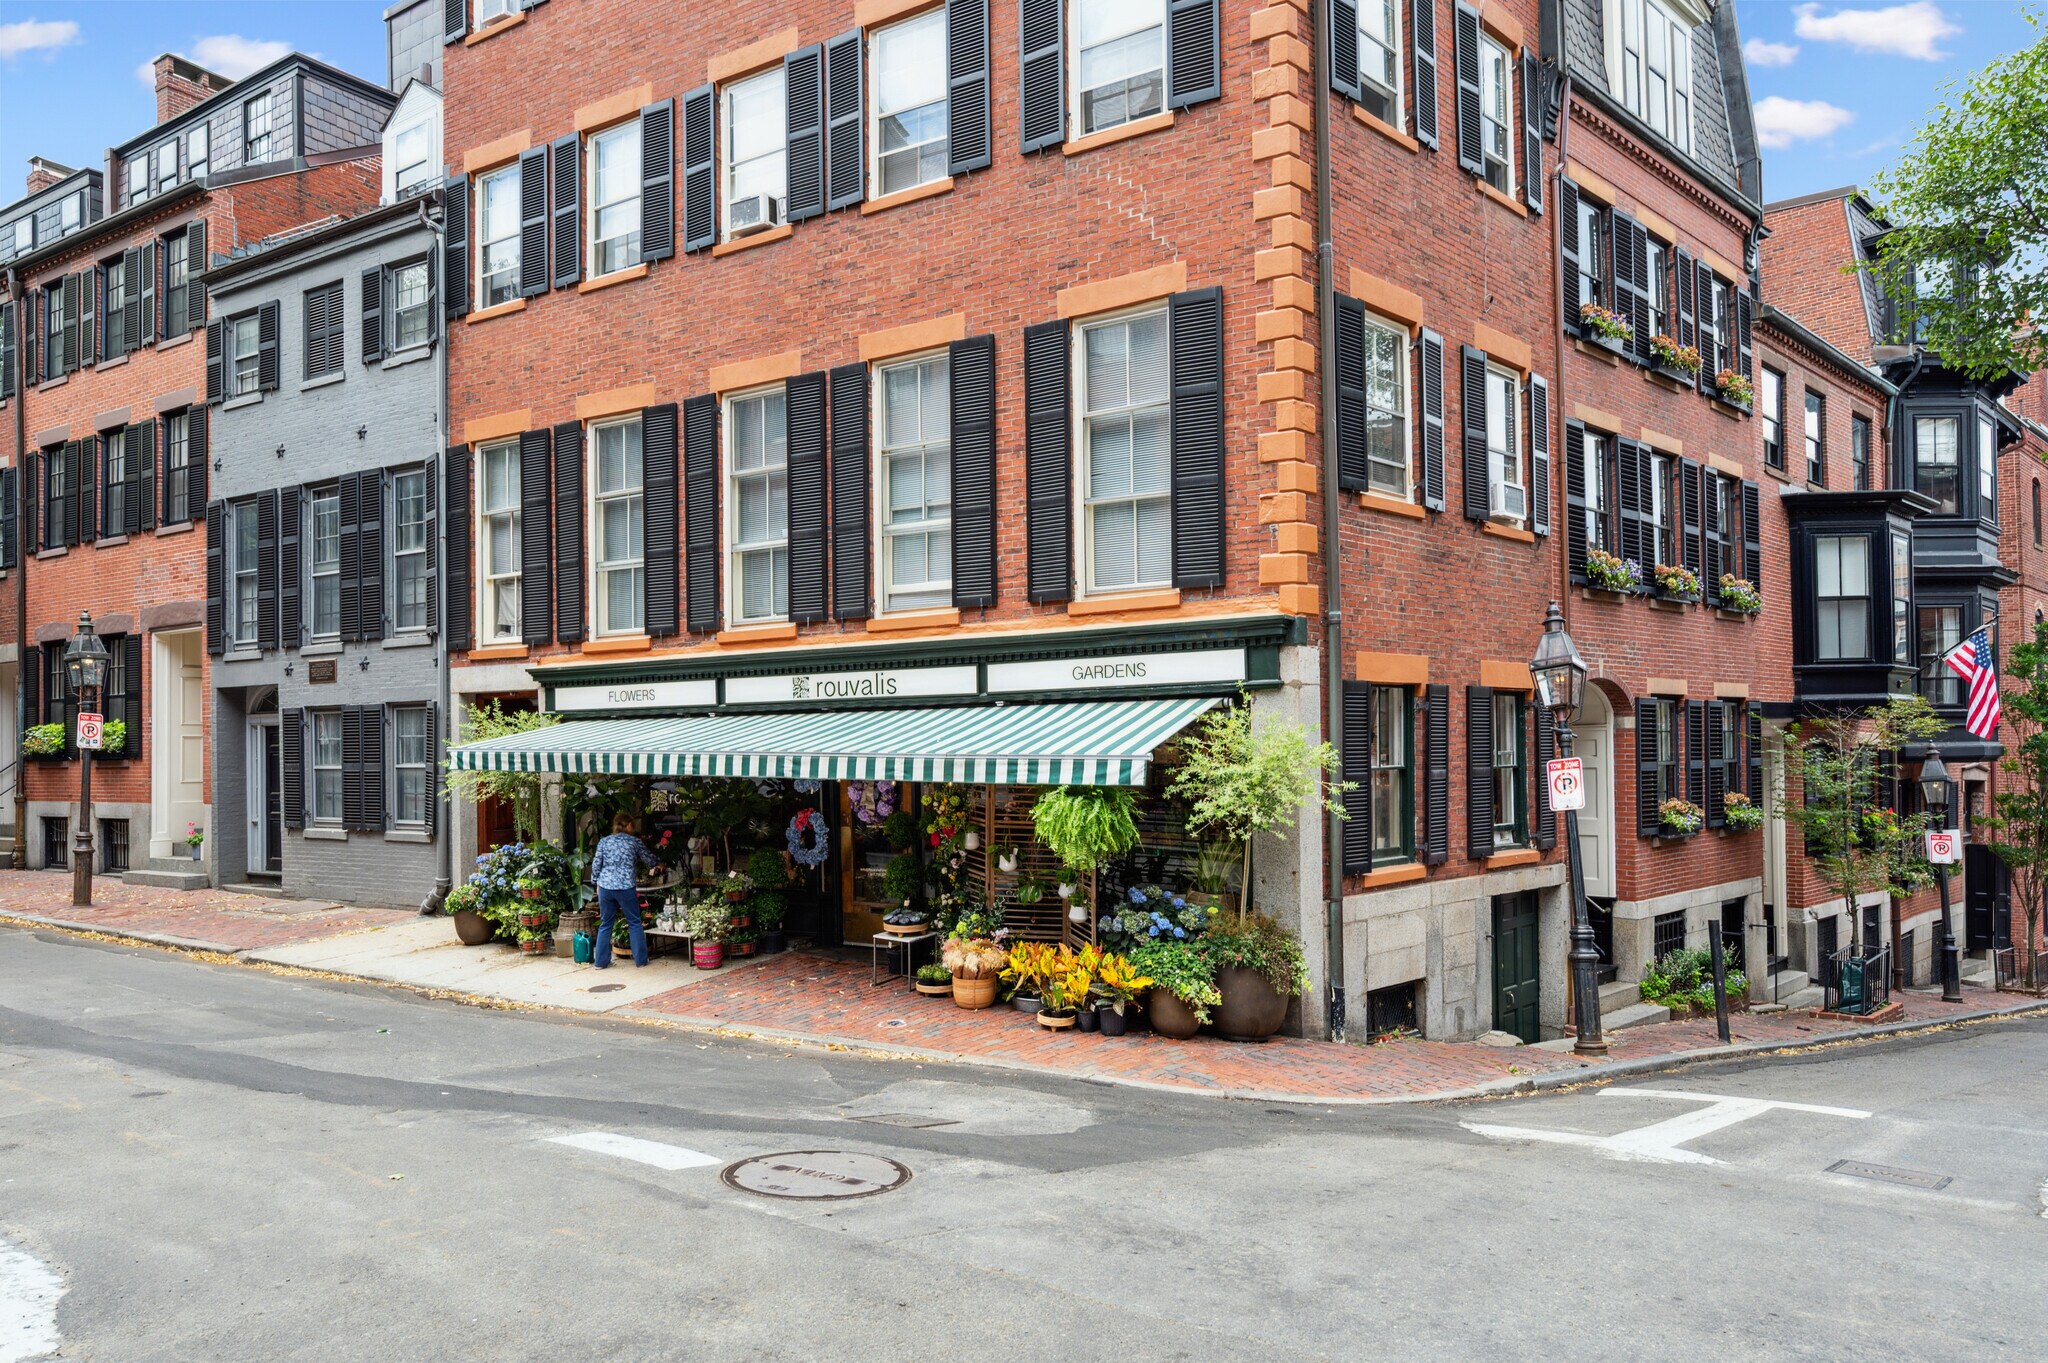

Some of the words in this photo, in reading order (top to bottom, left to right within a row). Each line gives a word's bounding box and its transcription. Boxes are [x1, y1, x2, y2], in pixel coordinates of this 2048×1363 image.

[1072, 662, 1147, 681] GARDENS
[816, 672, 897, 698] rouvalis
[608, 689, 656, 703] FLOWERS
[1565, 761, 1579, 769] ZONE
